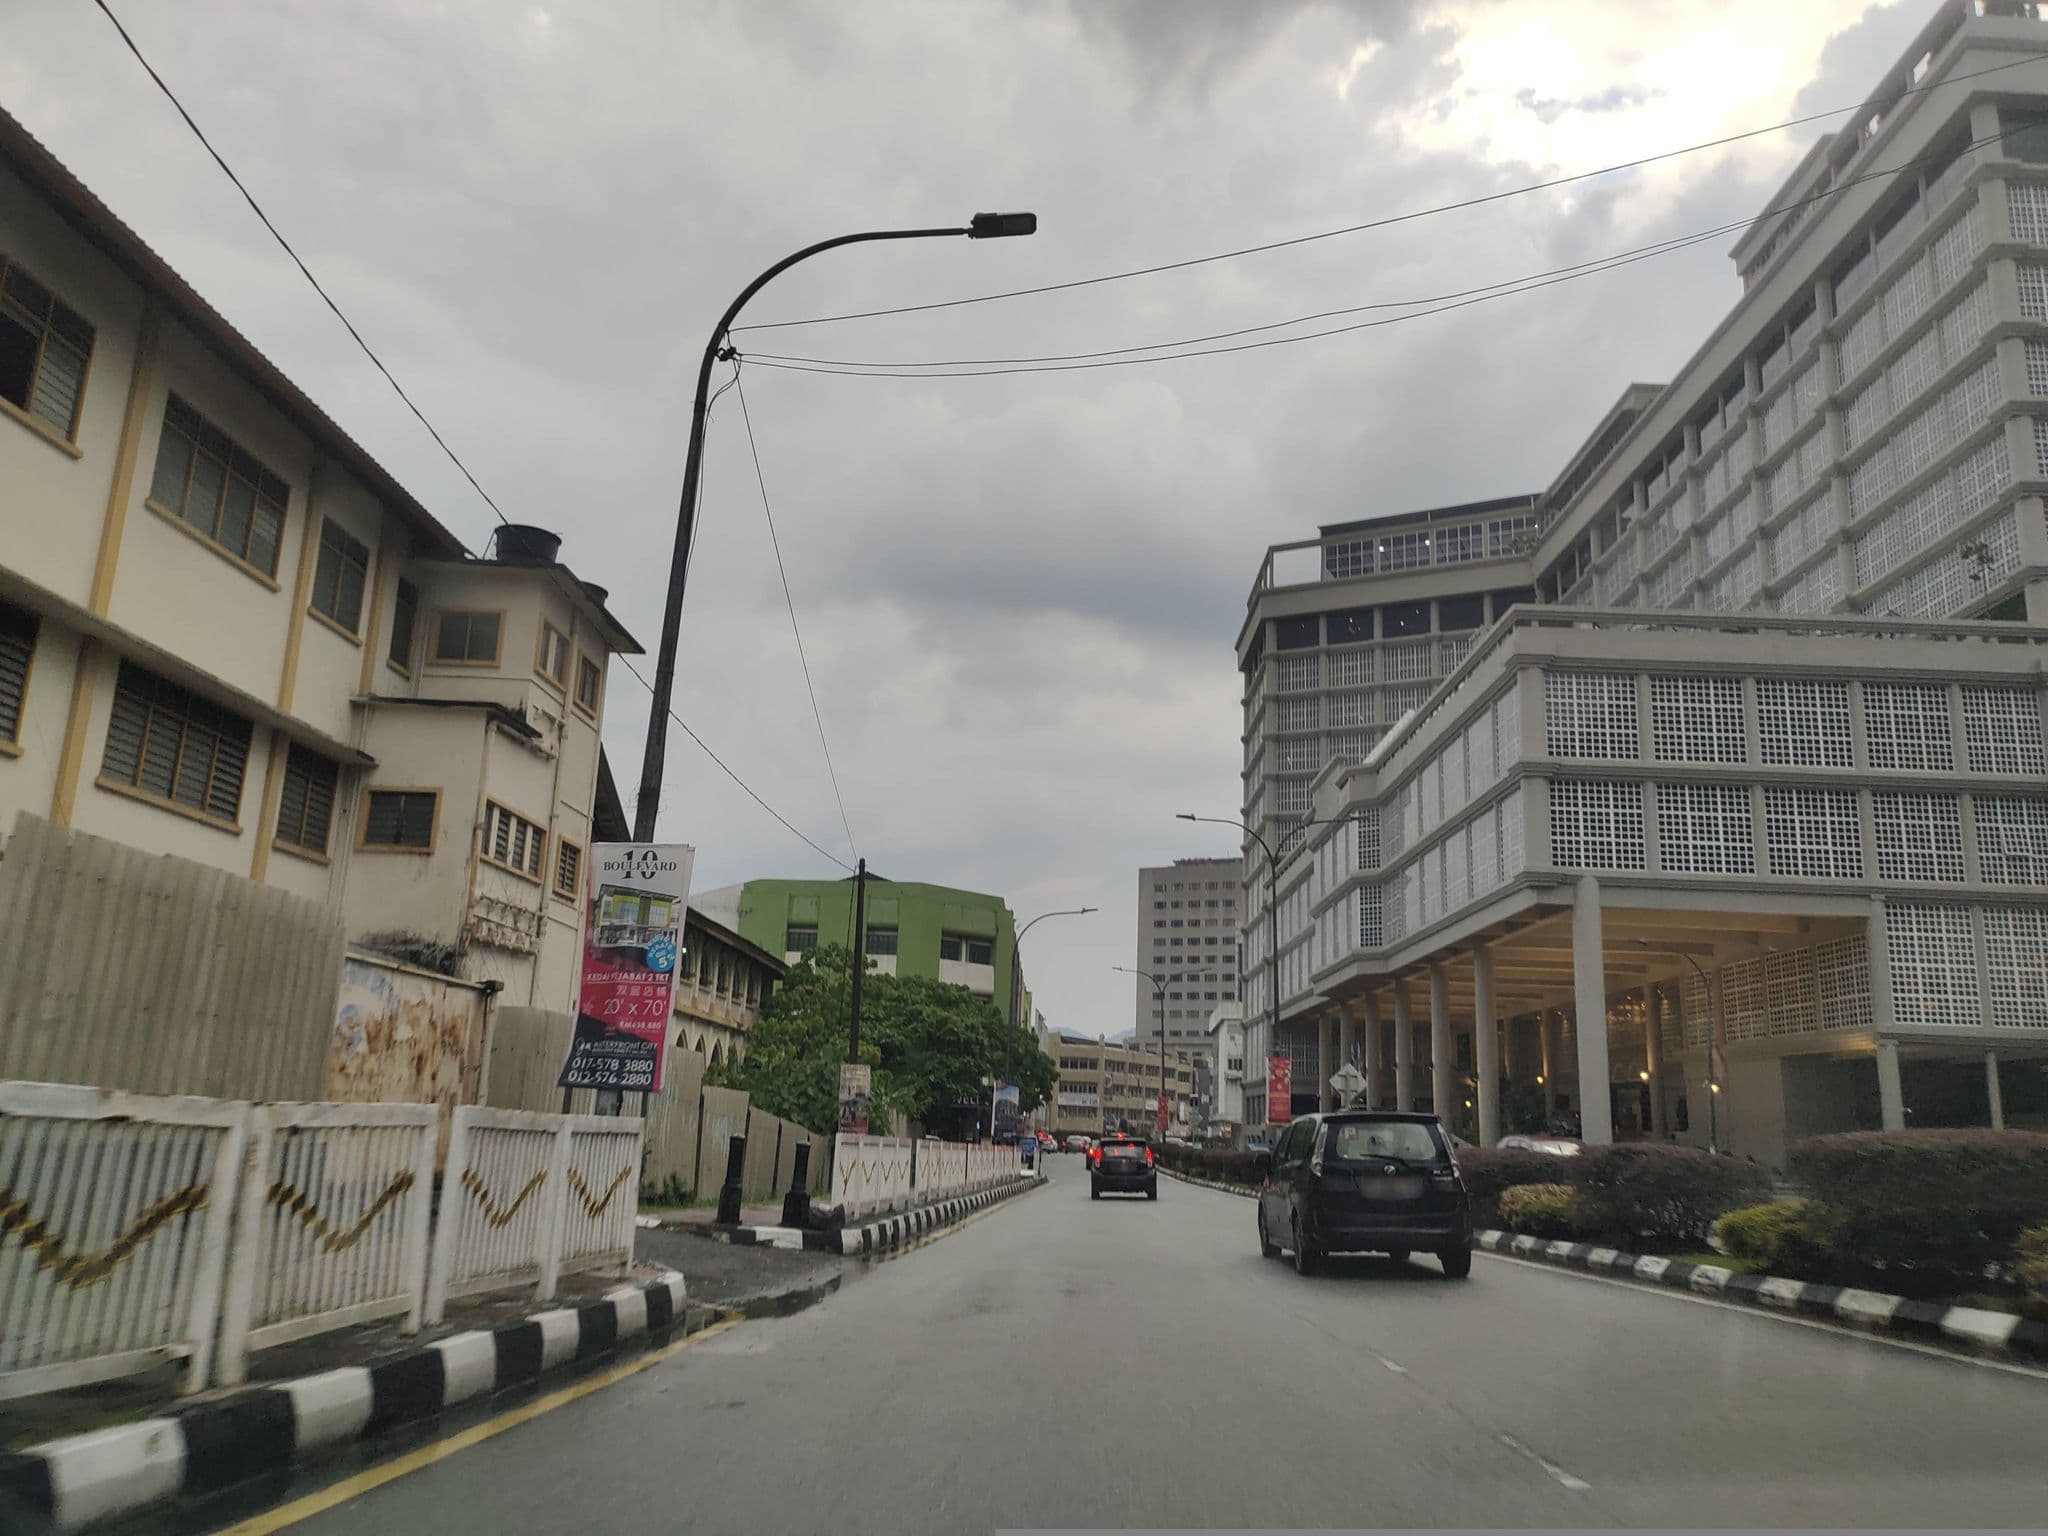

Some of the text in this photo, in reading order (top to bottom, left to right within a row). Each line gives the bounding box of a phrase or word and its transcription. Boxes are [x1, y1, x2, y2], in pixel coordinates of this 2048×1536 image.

[603, 861, 677, 871] BOULEVARD
[622, 850, 658, 880] 10
[643, 999, 667, 1016] 70'
[571, 1057, 653, 1072] 017-578 3880
[568, 1070, 652, 1085] 012-576 2880
